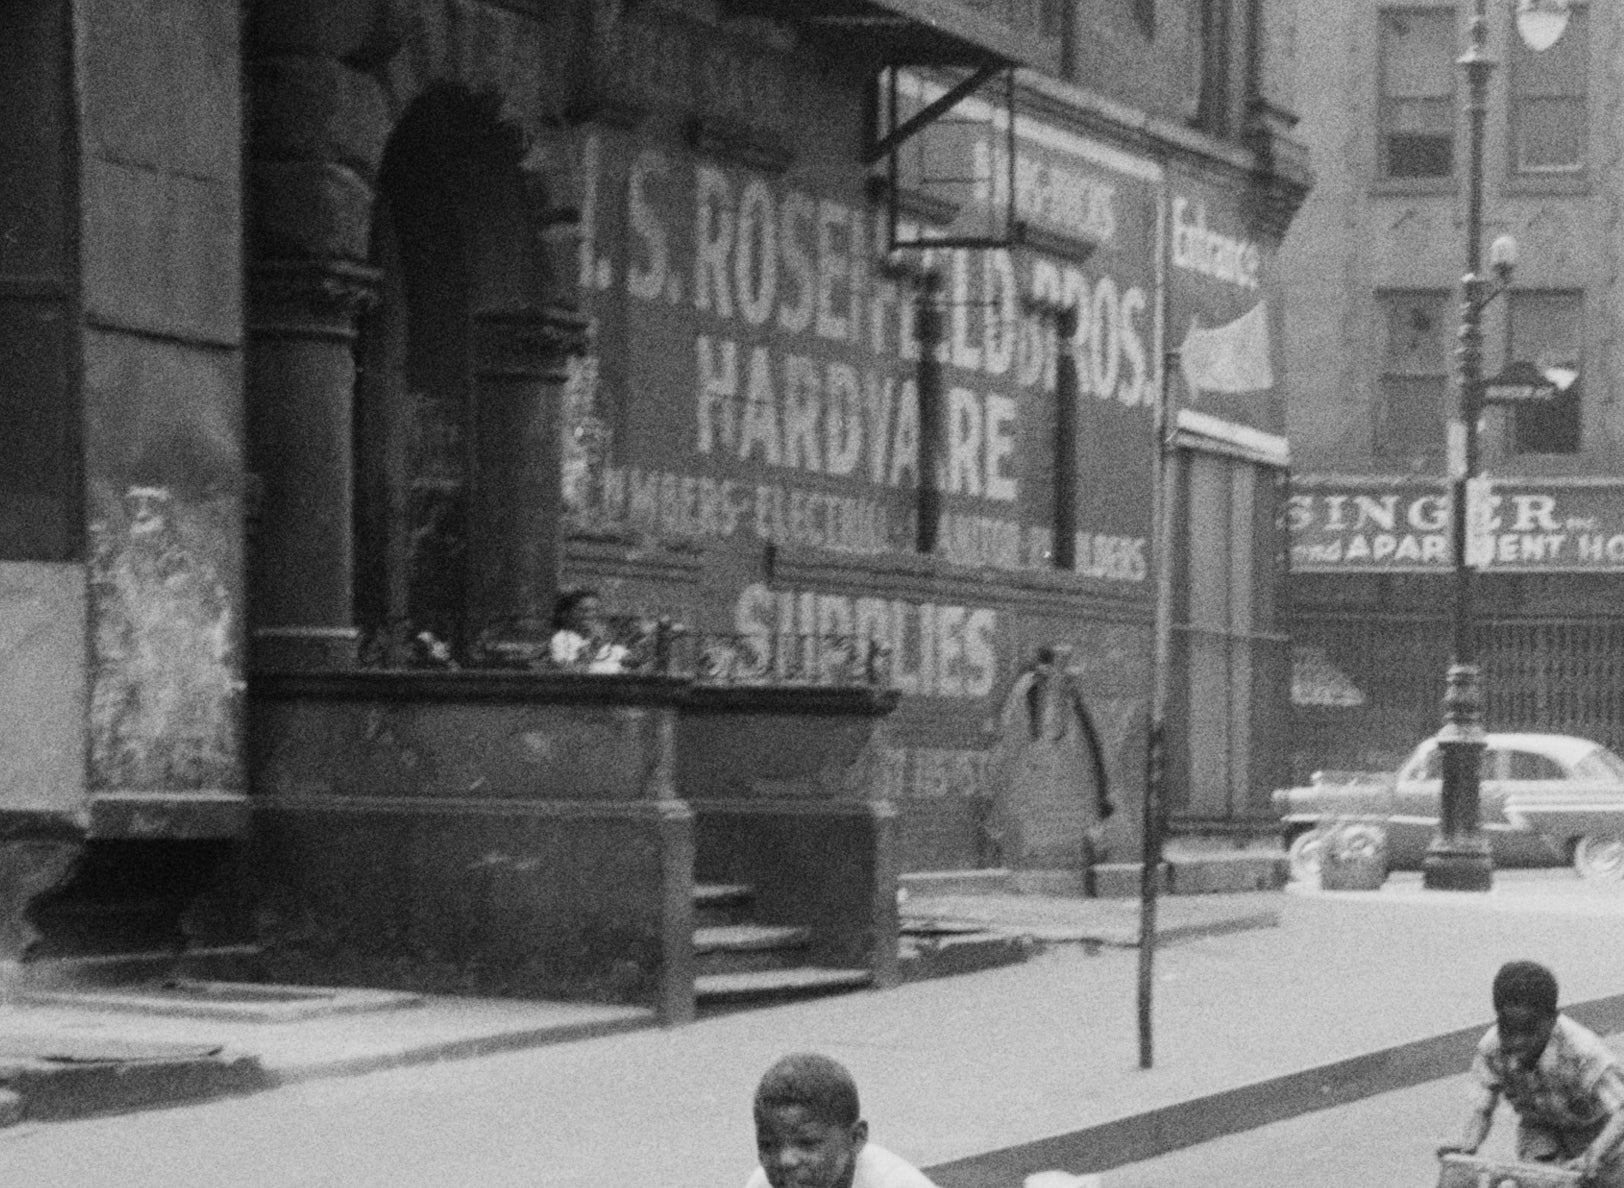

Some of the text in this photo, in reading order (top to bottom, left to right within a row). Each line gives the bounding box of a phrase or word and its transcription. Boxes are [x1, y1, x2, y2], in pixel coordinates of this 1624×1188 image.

[695, 333, 1019, 502] HARDWARE
[1287, 494, 1562, 531] SINGR
[1344, 533, 1566, 563] APARENT
